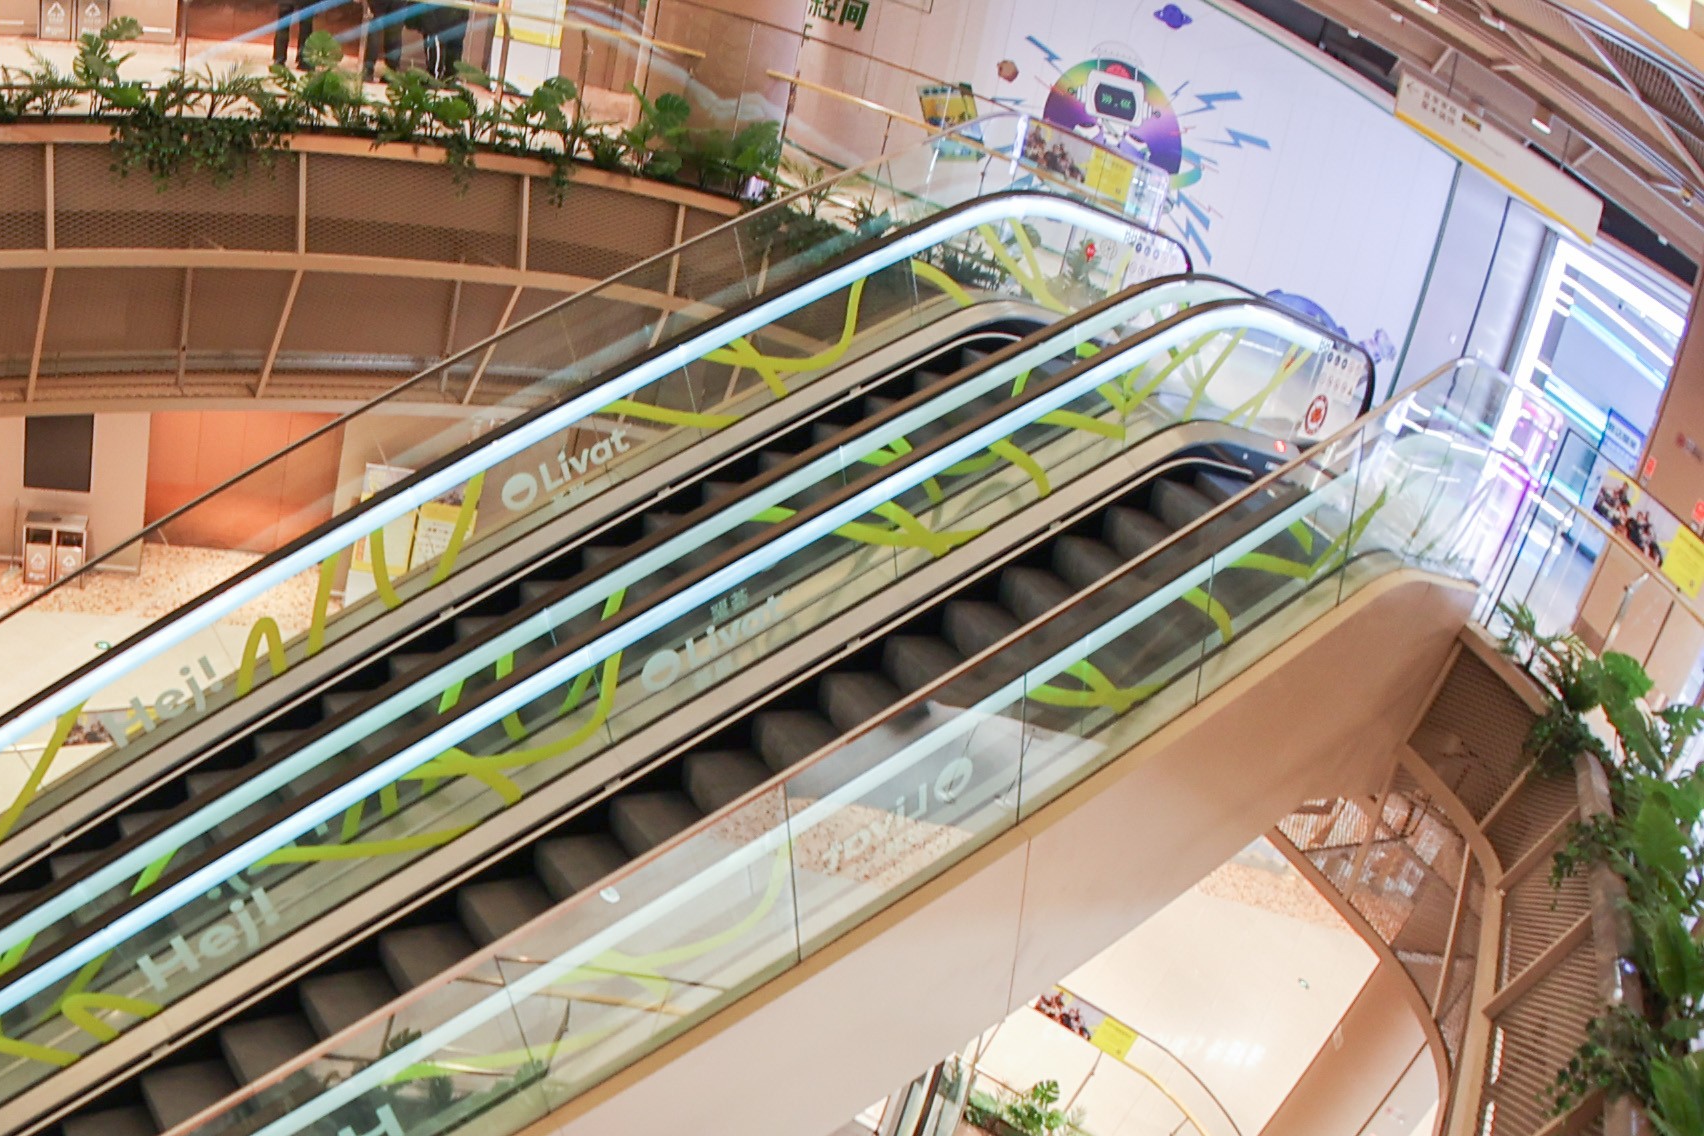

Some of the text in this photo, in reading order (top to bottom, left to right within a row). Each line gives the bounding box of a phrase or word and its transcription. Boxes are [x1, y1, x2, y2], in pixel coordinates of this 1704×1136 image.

[539, 428, 631, 492] Livat
[684, 594, 784, 666] Livat
[98, 655, 224, 749] Hej!
[136, 886, 281, 993] Hej!
